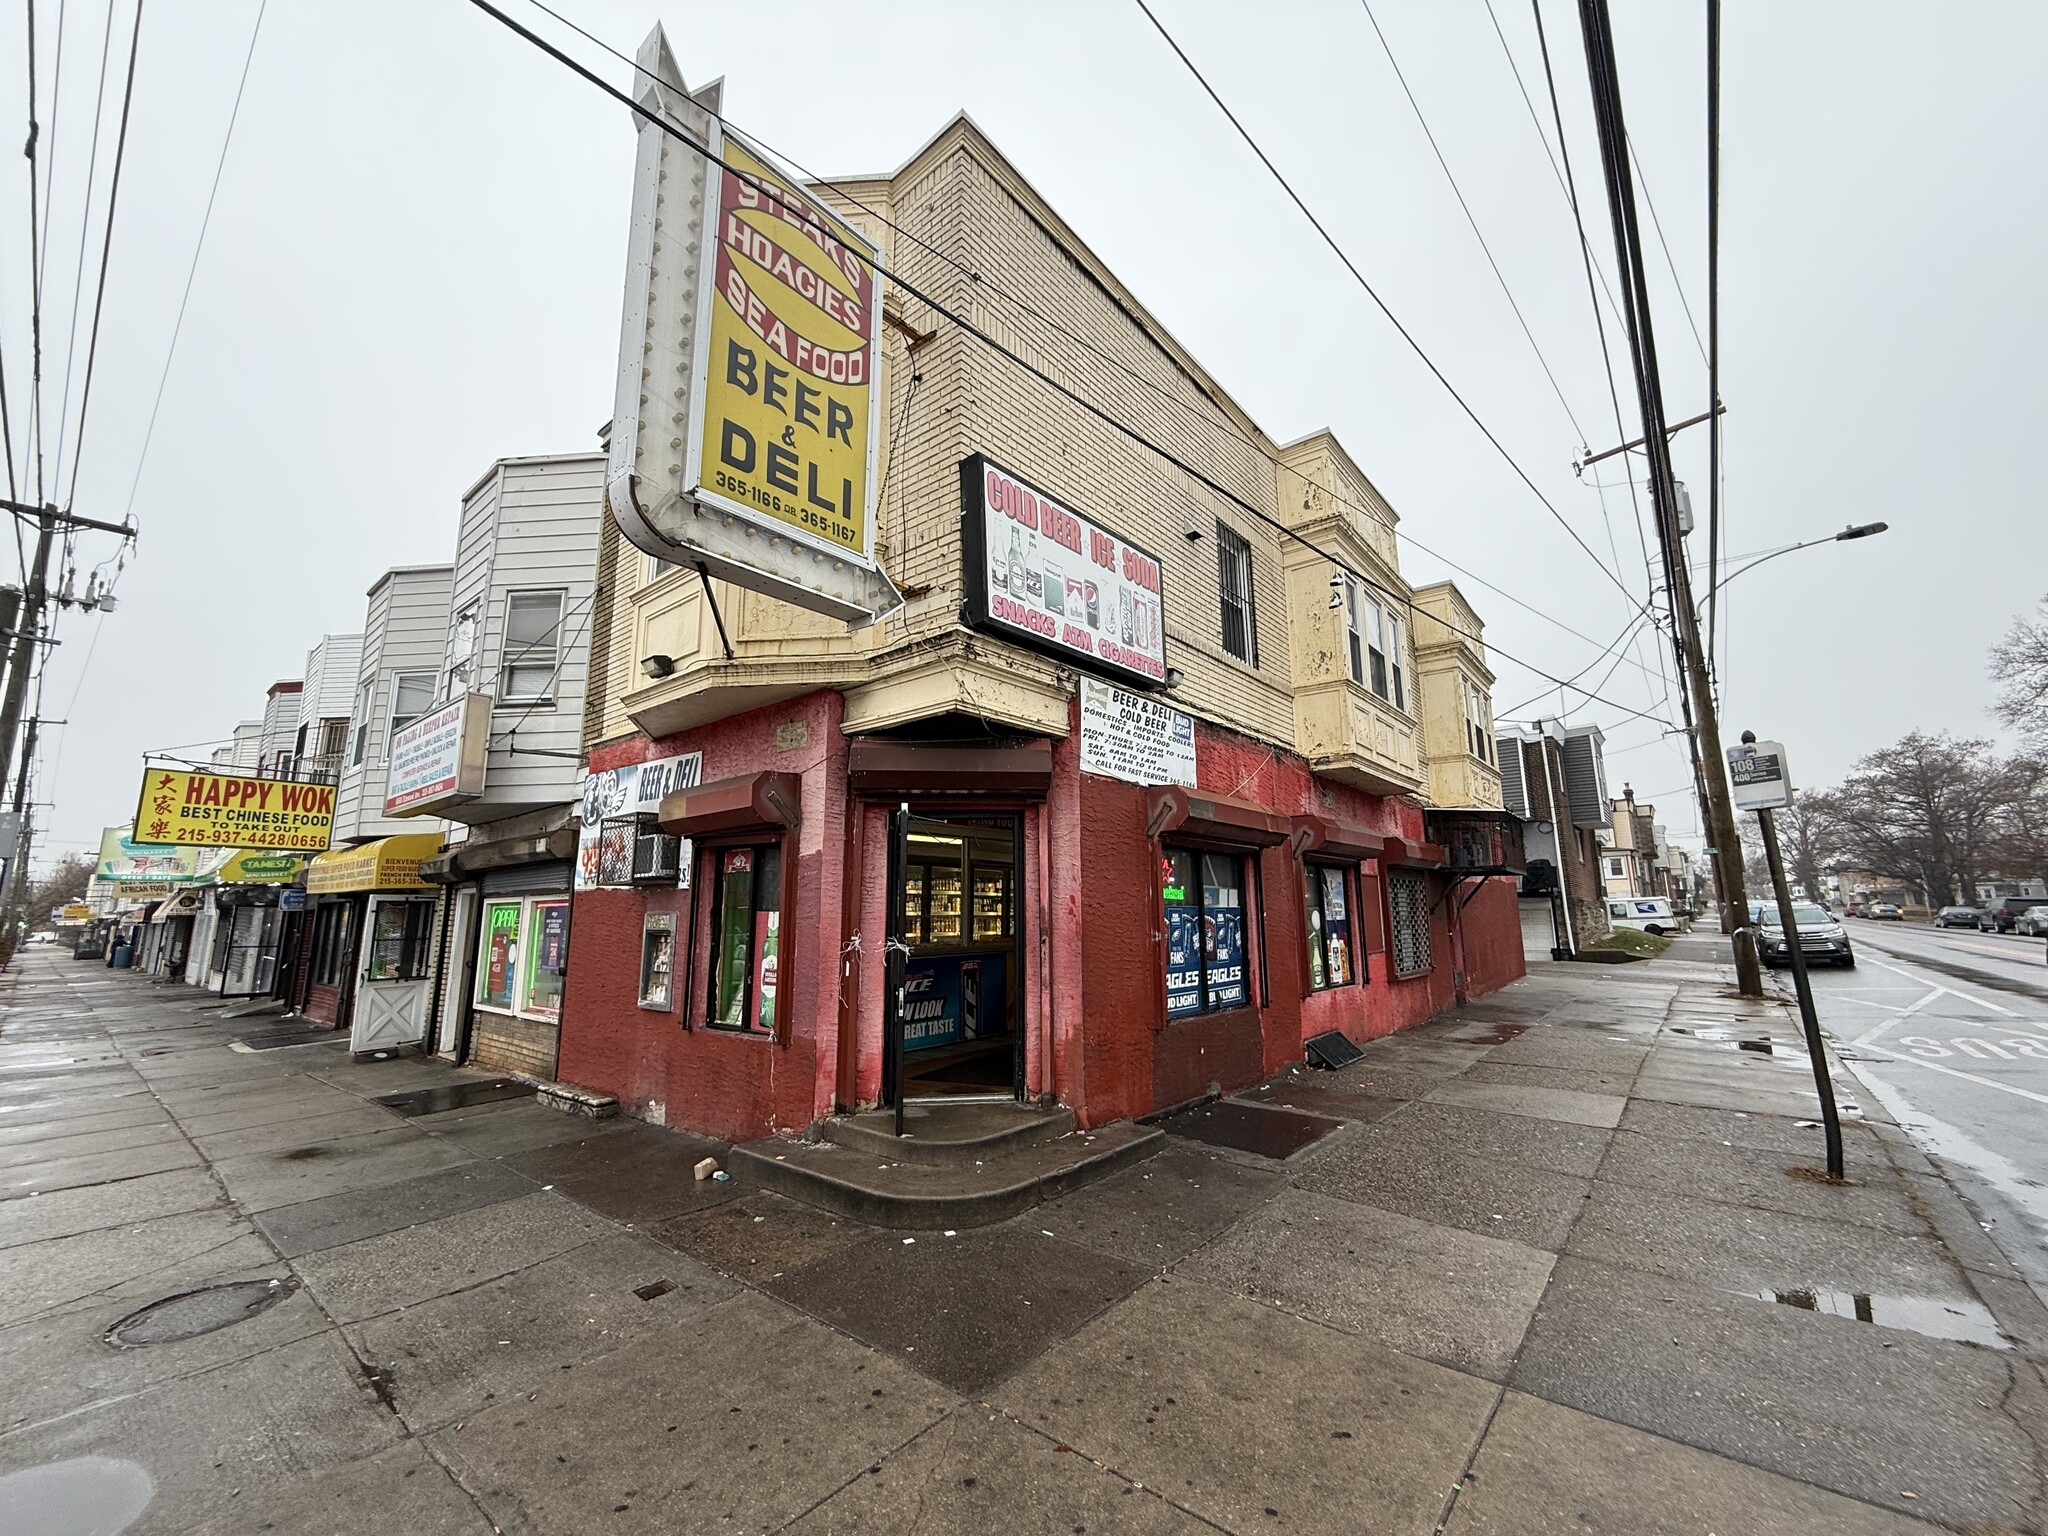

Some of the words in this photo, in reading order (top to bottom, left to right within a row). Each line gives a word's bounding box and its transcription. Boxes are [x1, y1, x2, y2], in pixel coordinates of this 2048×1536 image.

[738, 171, 861, 289] STEAKS
[727, 215, 861, 332] HOAGIES
[727, 337, 854, 449] BEER
[781, 425, 797, 448] &
[721, 418, 852, 521] DELI
[716, 470, 781, 512] 365-1166
[784, 504, 797, 517] OR
[800, 508, 856, 542] 365-1167
[987, 471, 1038, 531] COLD
[1040, 499, 1082, 556] BEER
[1090, 528, 1116, 574] ICE
[1122, 547, 1159, 595] SODA
[992, 594, 1056, 638] SNACKS
[1063, 624, 1093, 653] ATM
[1099, 638, 1164, 680] CIGARETTES
[1112, 690, 1138, 710] BEER
[1141, 701, 1148, 713] &
[1152, 704, 1171, 721] DELI
[1084, 707, 1127, 726] DOMESTICS
[1168, 736, 1194, 748] COOLERS
[1120, 708, 1142, 724] COLD
[1145, 716, 1166, 732] BEER
[1173, 723, 1190, 737] LIGHT
[1175, 714, 1190, 727] BUD
[1110, 723, 1125, 732] HOT
[1133, 732, 1151, 741] COLD
[1153, 738, 1170, 748] FOOD
[1087, 743, 1105, 751] SAT.
[1109, 749, 1127, 757] 8AM
[1141, 757, 1156, 765] 1AM
[1087, 749, 1108, 758] SUN.
[1113, 756, 1134, 765] 11AM
[1148, 765, 1168, 774] 11PM
[1177, 753, 1194, 761] 12AM
[1095, 759, 1112, 769] CALL
[1114, 763, 1127, 772] FOR
[1128, 767, 1142, 776] FAST
[1143, 771, 1168, 782] SERVICE
[1170, 777, 1195, 788] 365-1166
[1731, 759, 1755, 772] 108
[638, 764, 664, 802] BEER
[663, 767, 672, 796] &
[1733, 773, 1750, 782] 400
[185, 776, 275, 810] HAPPY
[282, 785, 334, 814] WOK
[180, 805, 222, 820] BEST
[227, 809, 289, 825] CHINESE
[293, 814, 329, 827] FOOD
[210, 821, 229, 829] TO
[234, 822, 270, 832] TAKE
[274, 825, 300, 833] OUT
[176, 828, 326, 848] 215-937-4428/0656
[356, 857, 376, 869] MARKET
[121, 885, 148, 893] AFRICAN
[493, 910, 517, 928] OPEN
[1170, 951, 1184, 964] FANS
[1217, 948, 1229, 960] FANS
[1166, 971, 1199, 989] AGLES
[1207, 966, 1241, 984] EAGLES
[1176, 994, 1197, 1008] LIGHT
[1222, 988, 1240, 999] LIGHT
[913, 1000, 944, 1020] LOOK
[904, 1021, 927, 1040] REAT
[928, 1018, 954, 1036] TASTE
